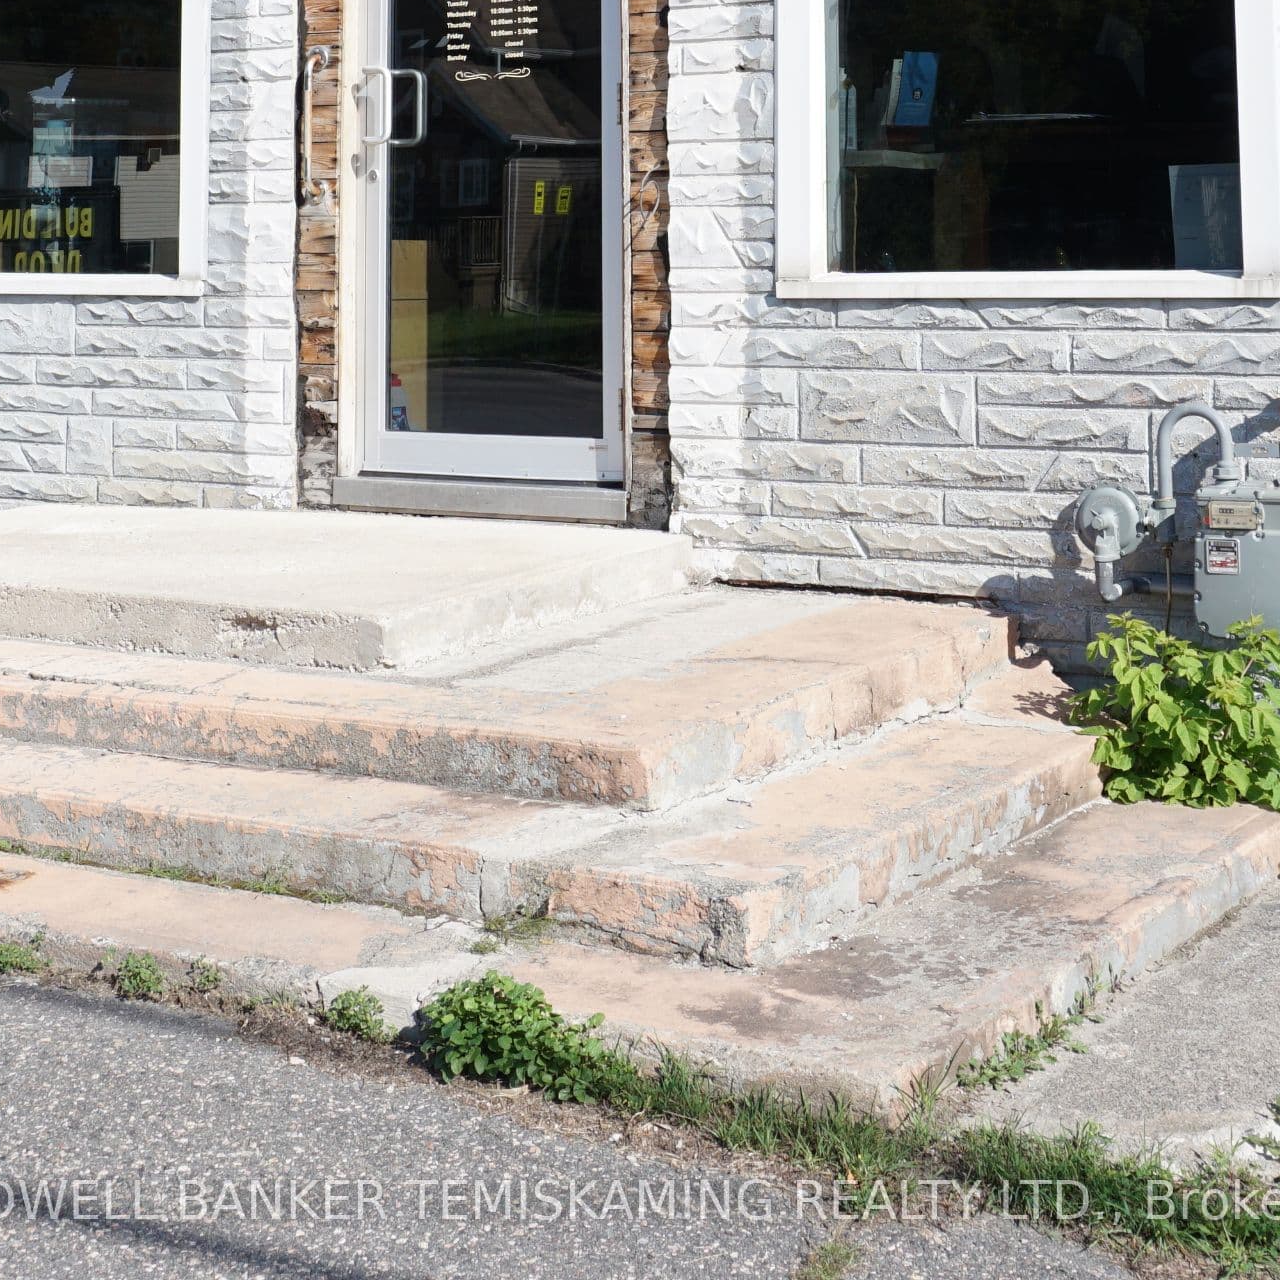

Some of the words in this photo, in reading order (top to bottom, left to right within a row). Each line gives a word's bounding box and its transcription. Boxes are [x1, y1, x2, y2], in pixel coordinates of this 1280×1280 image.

[447, 10, 477, 18] Wednesday
[447, 43, 471, 51] Saturday
[447, 54, 467, 62] Sunday
[504, 51, 524, 59] closed
